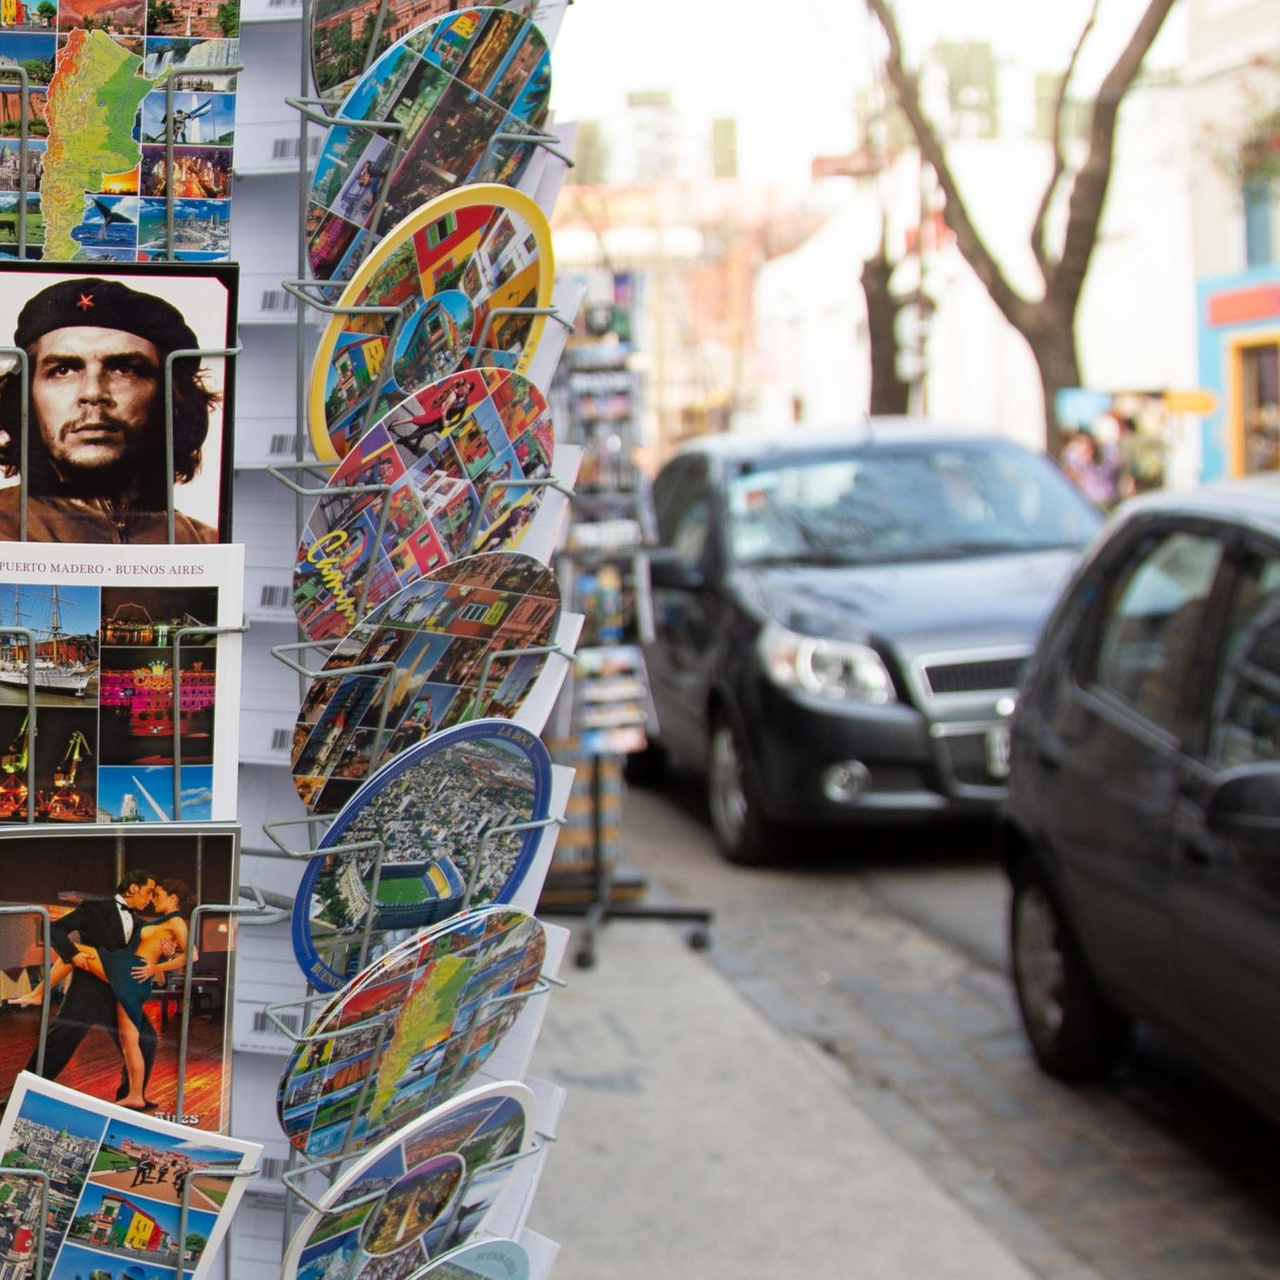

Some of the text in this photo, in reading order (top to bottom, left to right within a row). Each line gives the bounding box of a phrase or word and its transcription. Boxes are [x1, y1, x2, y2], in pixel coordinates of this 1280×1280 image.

[50, 563, 104, 574] MADERO
[115, 565, 166, 575] BUENOS
[168, 565, 205, 575] AIRES
